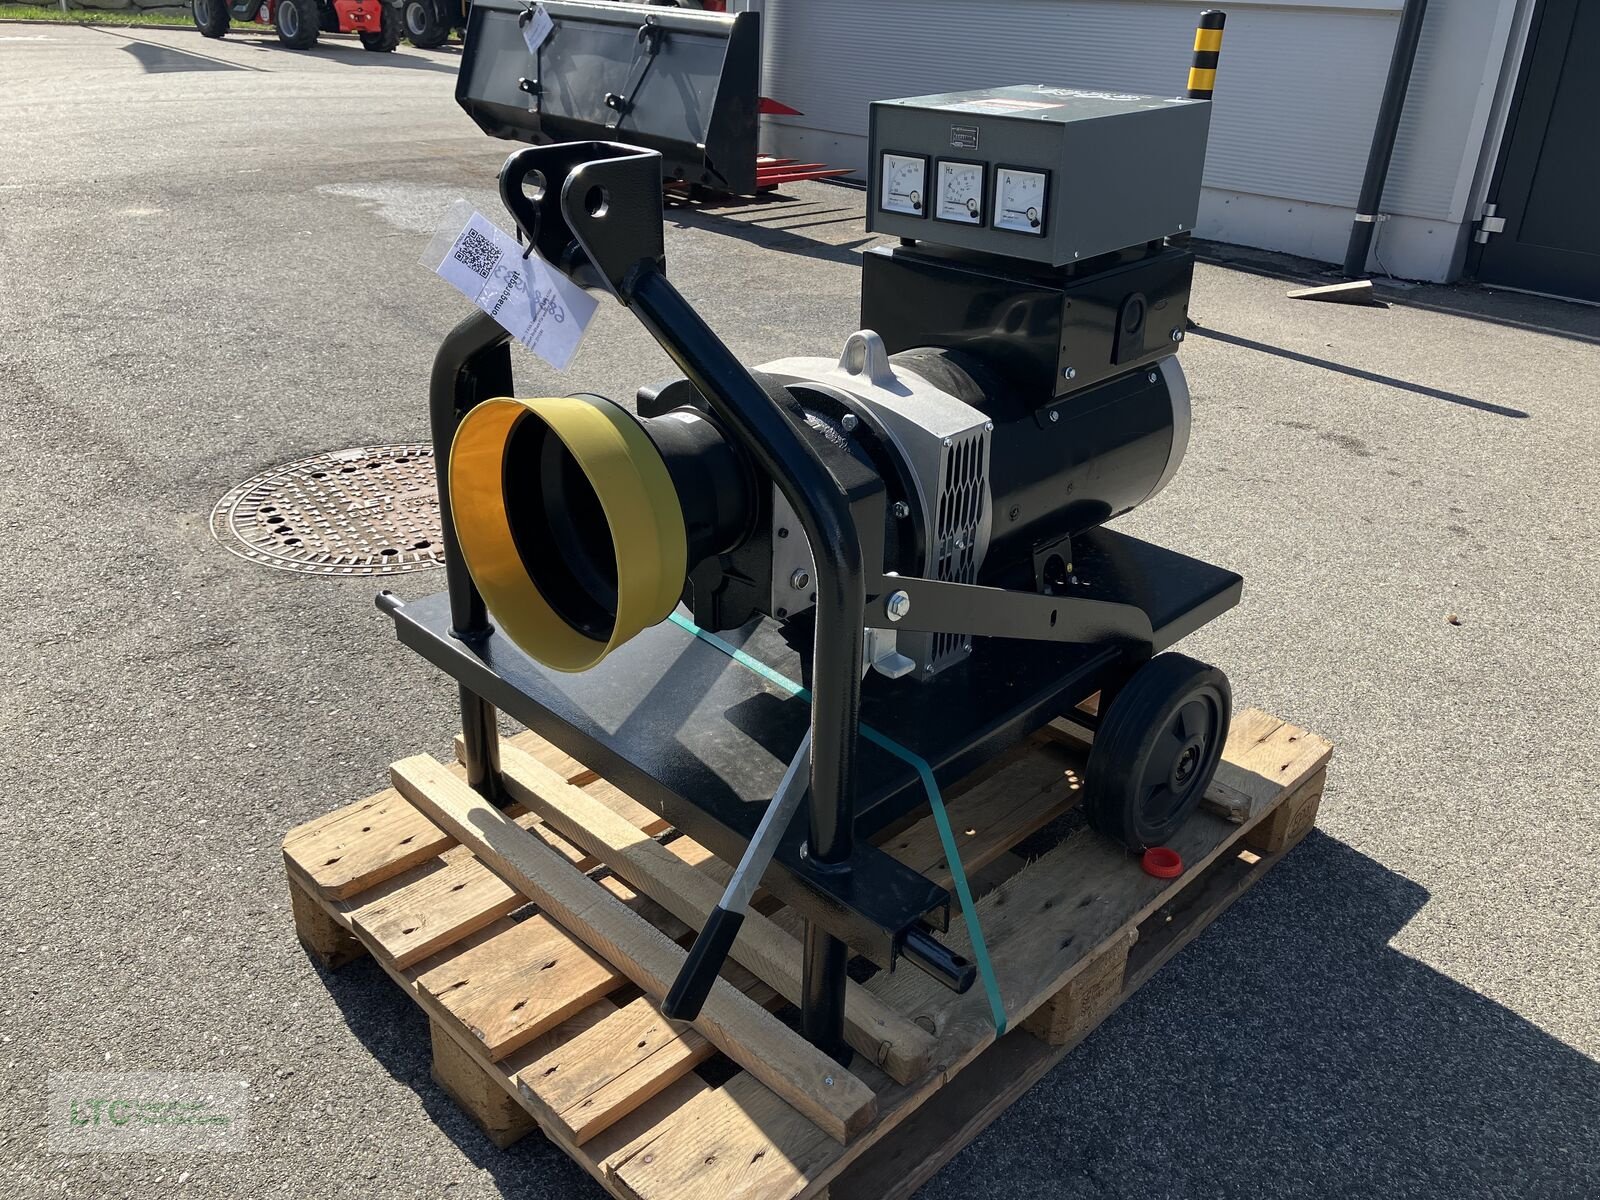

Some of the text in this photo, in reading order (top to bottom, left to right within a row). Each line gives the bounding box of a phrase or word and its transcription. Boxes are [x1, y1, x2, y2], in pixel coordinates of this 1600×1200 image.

[945, 166, 953, 175] Hz
[1005, 176, 1011, 185] A
[346, 495, 395, 512] AET
[348, 505, 395, 518] EURO
